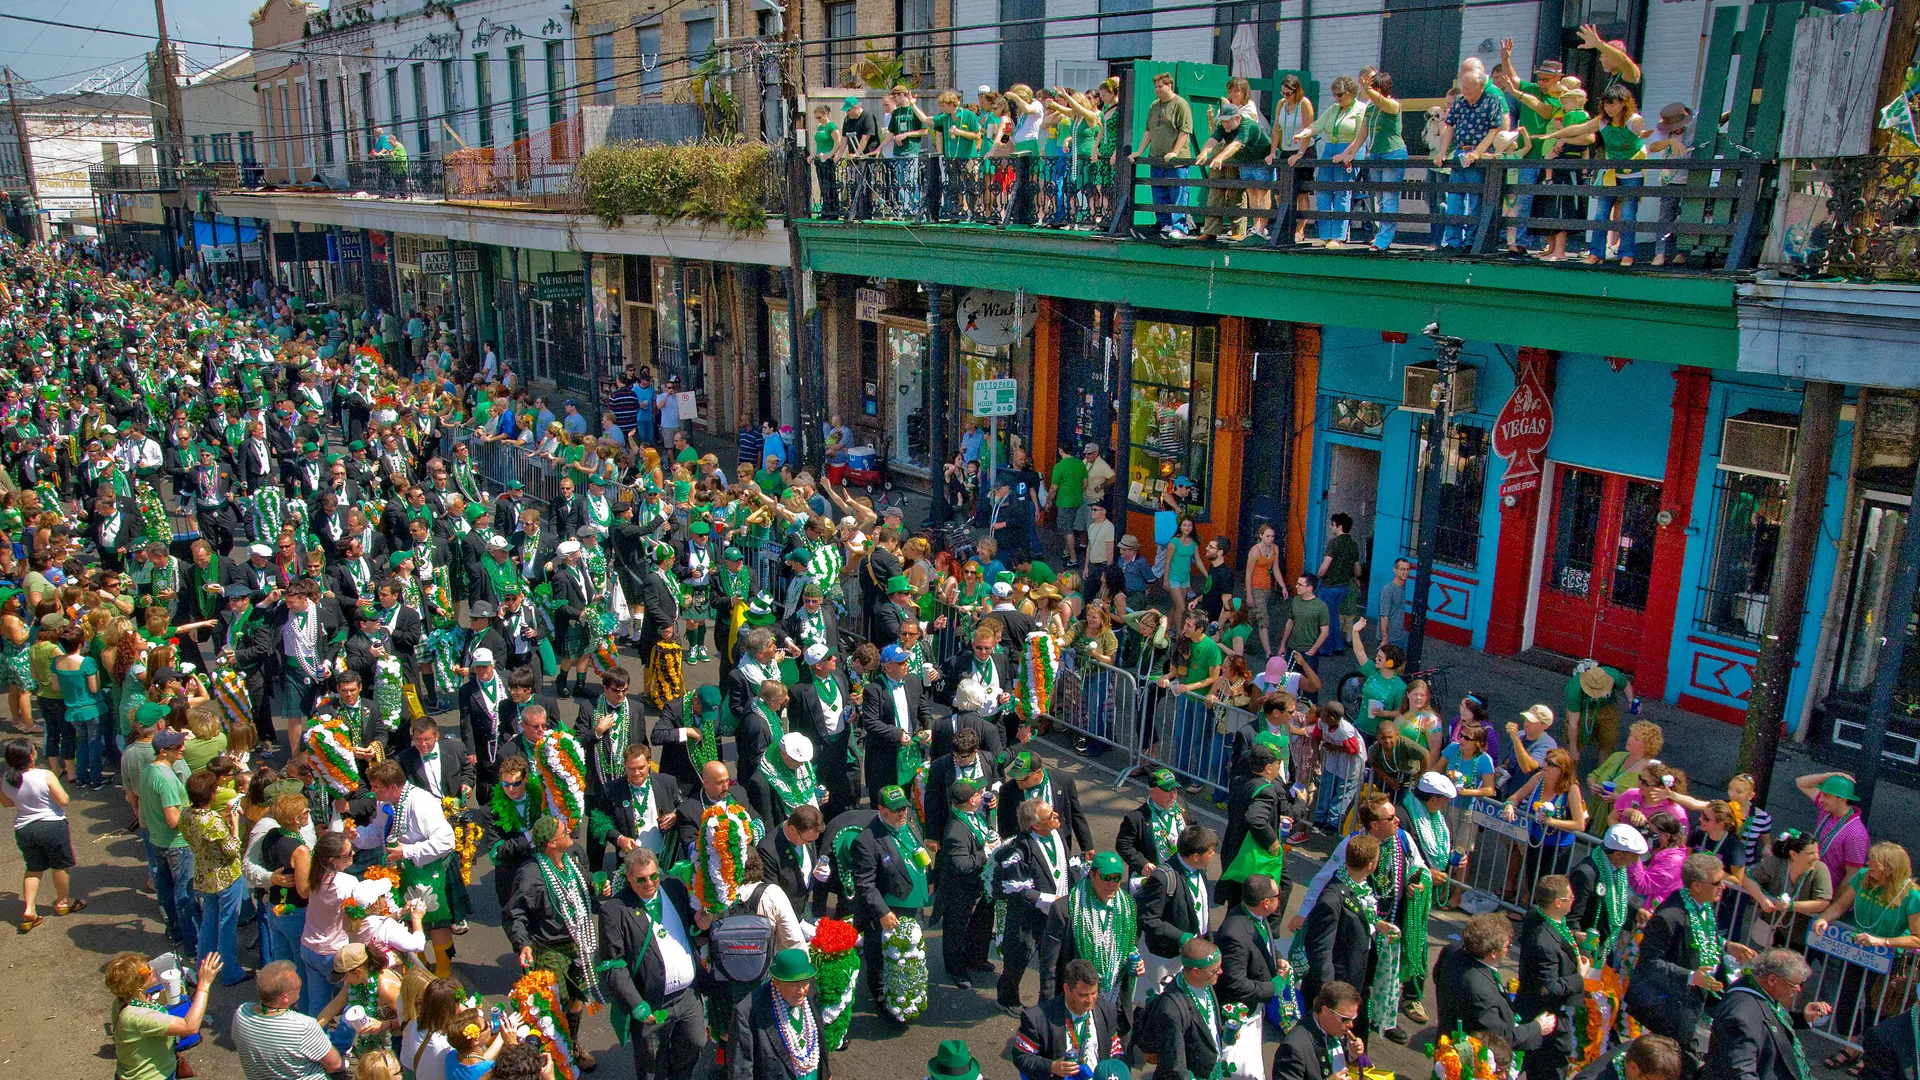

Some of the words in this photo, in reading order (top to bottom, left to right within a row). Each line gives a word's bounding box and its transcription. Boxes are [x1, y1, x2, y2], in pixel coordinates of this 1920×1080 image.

[425, 251, 475, 262] ANTIUES
[425, 260, 477, 272] MAGINE
[976, 383, 989, 391] PAY
[998, 380, 1015, 389] PARK
[983, 390, 989, 400] 2
[977, 400, 994, 408] HOUR
[1501, 416, 1547, 441] VEGAS
[1521, 480, 1537, 490] STORE
[1822, 936, 1851, 953] POLICE
[1856, 950, 1876, 961] LINE
[1814, 940, 1826, 949] DO
[1831, 946, 1848, 957] NOT
[1852, 954, 1879, 969] CROSS
